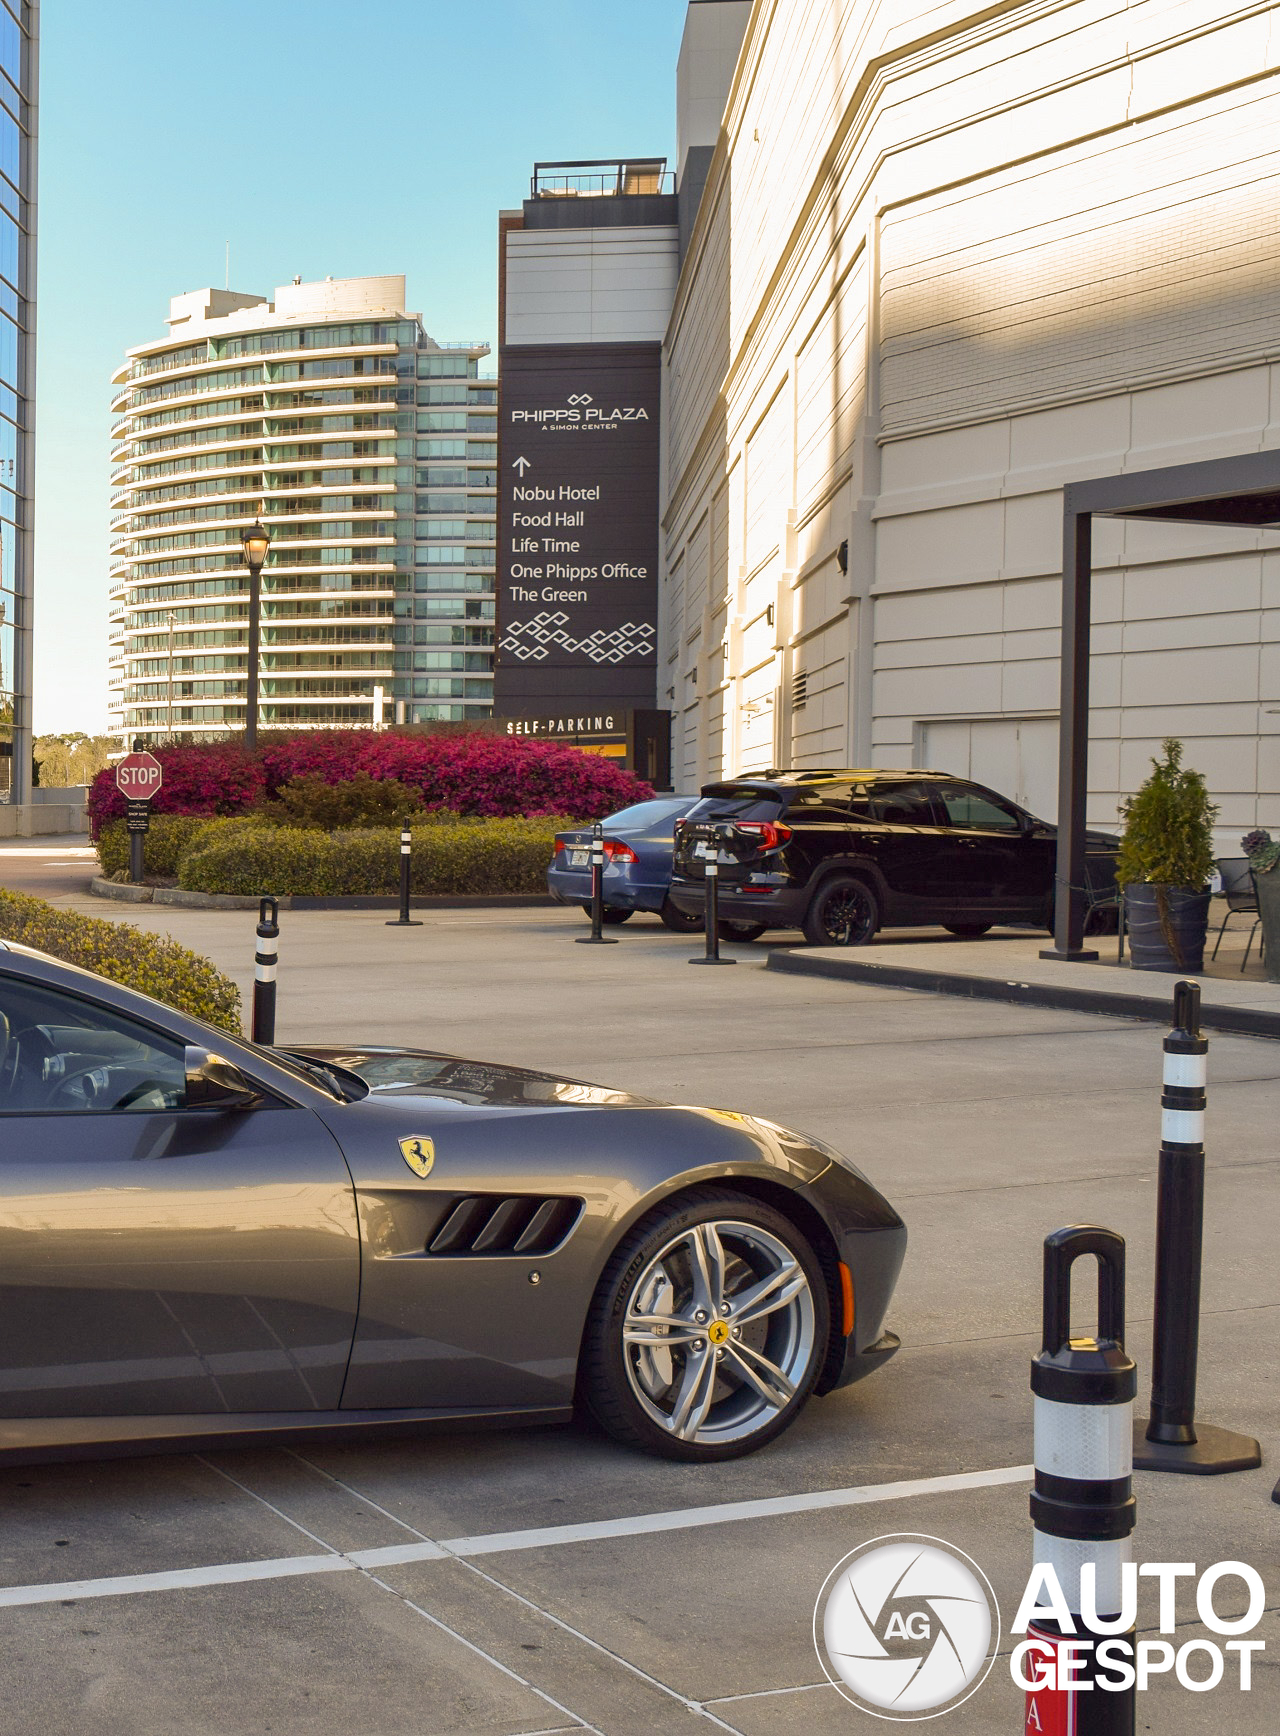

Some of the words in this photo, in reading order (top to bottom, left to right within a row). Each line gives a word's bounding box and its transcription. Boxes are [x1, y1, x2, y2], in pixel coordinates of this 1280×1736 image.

[511, 408, 581, 423] PHIPPS
[585, 407, 649, 421] PLAZA
[512, 486, 556, 501] Nobu
[559, 486, 600, 501] Hotel
[512, 512, 552, 527] Food
[555, 511, 584, 527] Hall
[511, 538, 539, 553] Life
[541, 538, 580, 553] Time
[509, 564, 542, 579] One
[546, 563, 598, 582] Phipps
[601, 563, 647, 579] Office
[509, 587, 539, 602] The
[541, 587, 588, 602] Green
[506, 716, 614, 735] SELF-PARKING
[120, 767, 159, 785] STOP
